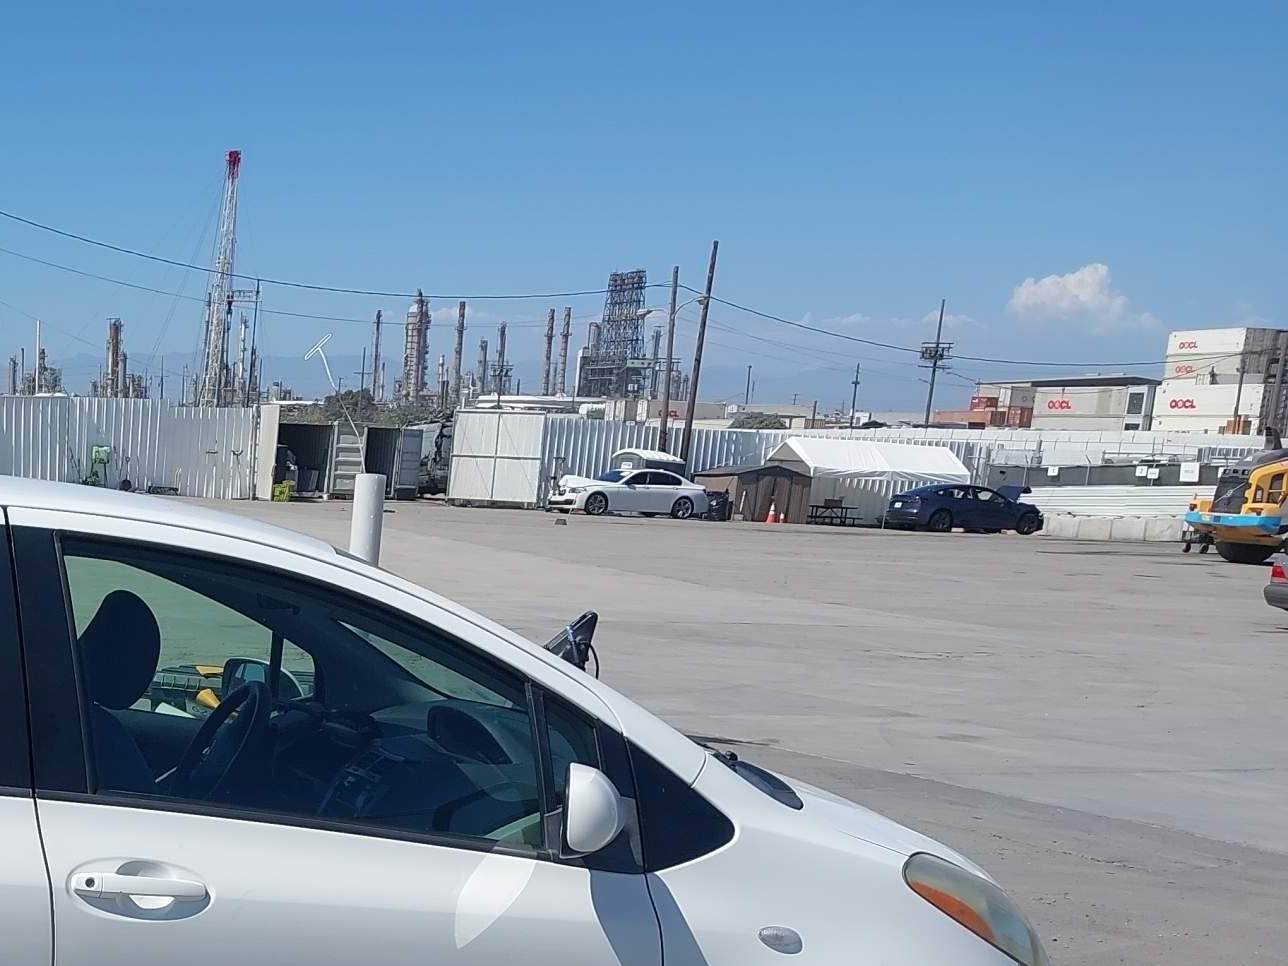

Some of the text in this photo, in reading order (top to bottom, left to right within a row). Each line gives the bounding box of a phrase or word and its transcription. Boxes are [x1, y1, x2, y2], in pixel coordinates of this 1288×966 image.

[1178, 341, 1198, 349] OOCL
[1047, 399, 1072, 410] OOCL
[1169, 398, 1197, 409] OOCL
